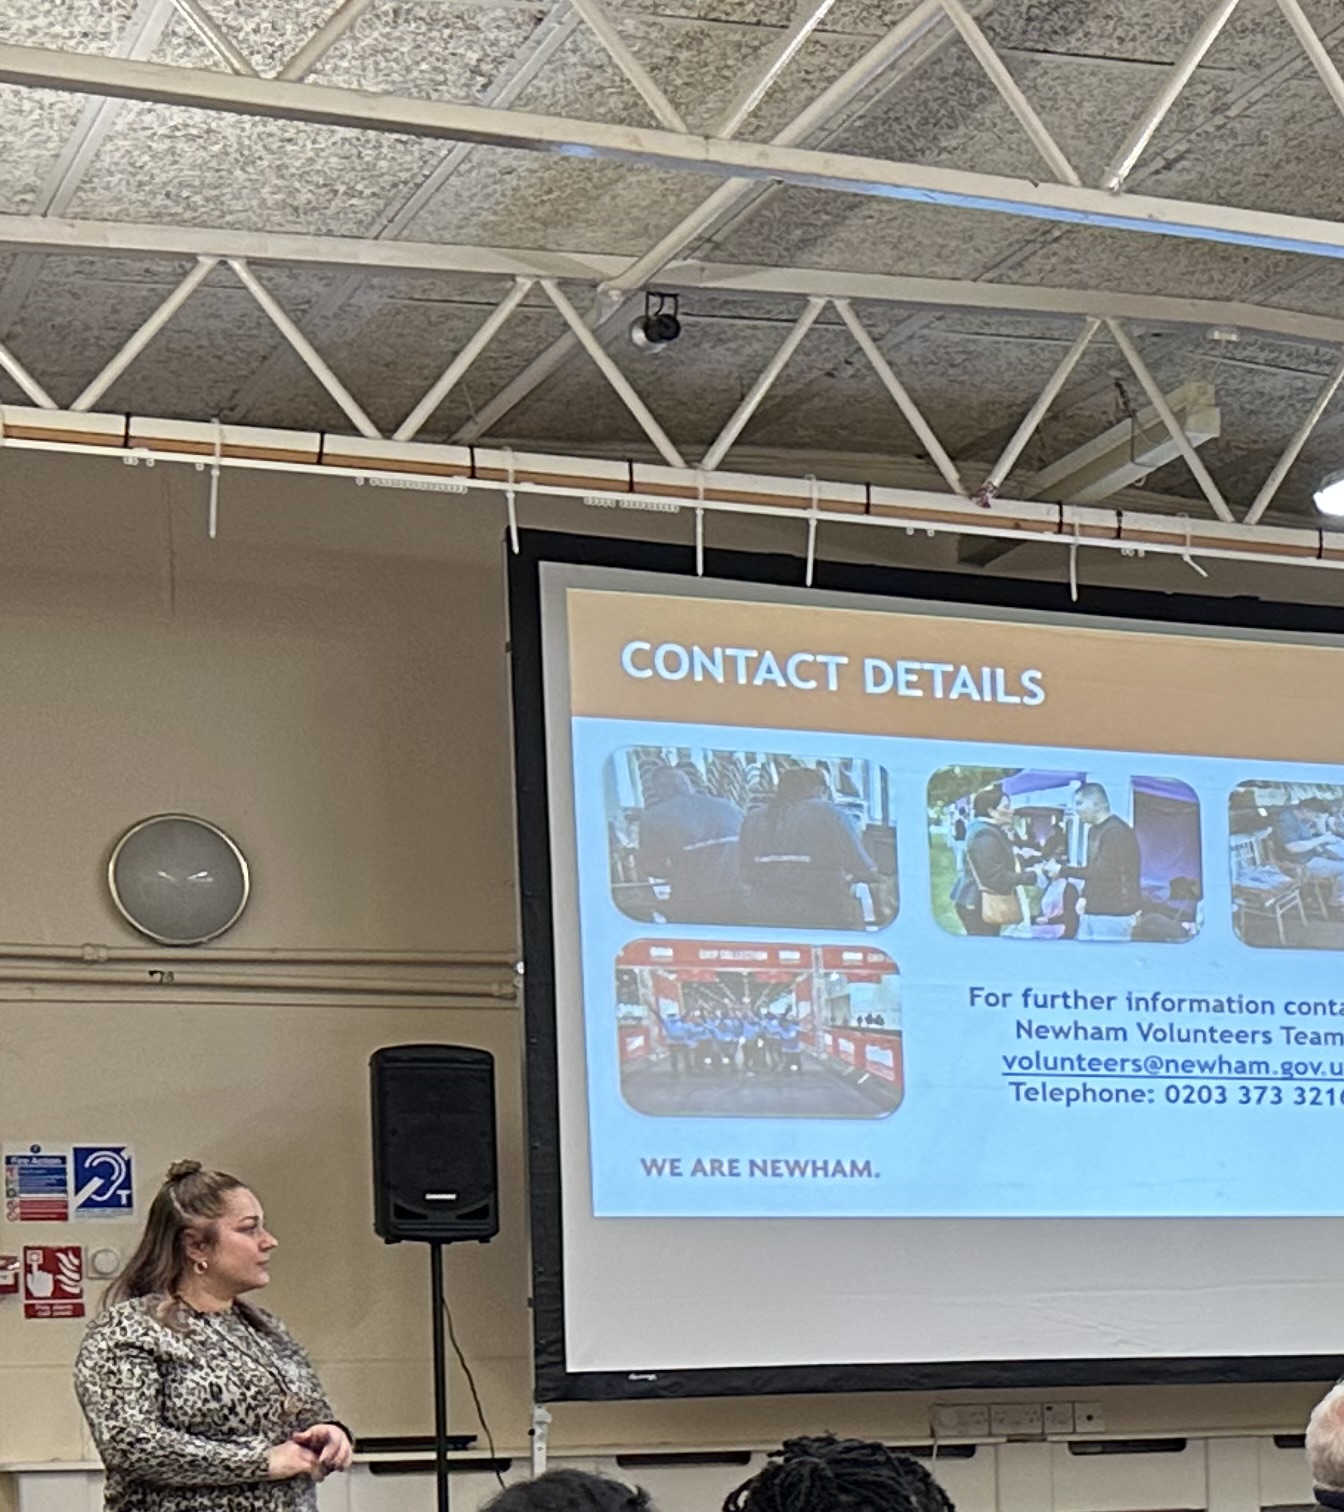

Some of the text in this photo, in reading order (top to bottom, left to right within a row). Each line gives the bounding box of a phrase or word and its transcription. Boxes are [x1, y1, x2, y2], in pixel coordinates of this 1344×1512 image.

[621, 641, 1046, 706] CONTACT DETAILS
[968, 986, 1013, 1009] For
[1022, 988, 1117, 1011] further
[1126, 991, 1275, 1016] information
[1016, 1019, 1344, 1047] Newham Volunteers Team
[1008, 1082, 1155, 1108] Telephone:
[1165, 1084, 1229, 1106] 0203
[1238, 1085, 1283, 1106] 373
[640, 1158, 881, 1179] WE ARE NEWHAM.
[116, 1189, 131, 1206] T
